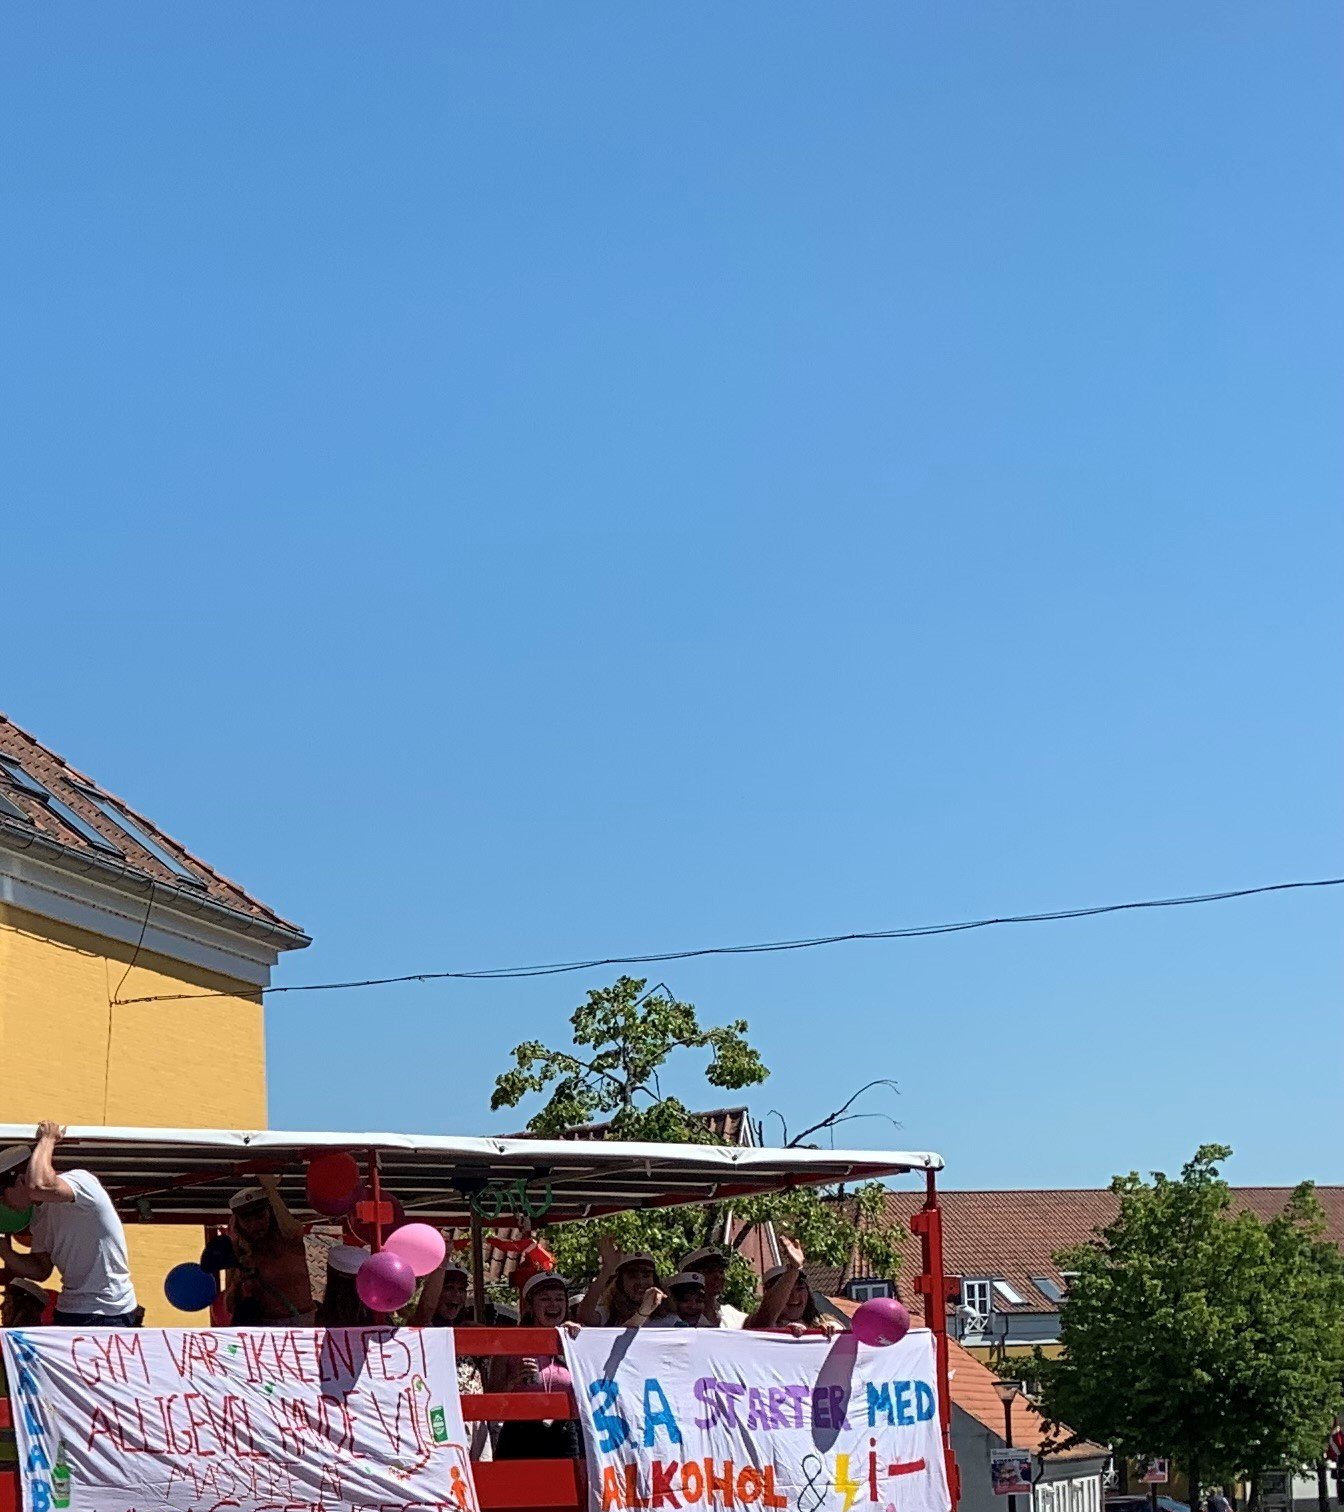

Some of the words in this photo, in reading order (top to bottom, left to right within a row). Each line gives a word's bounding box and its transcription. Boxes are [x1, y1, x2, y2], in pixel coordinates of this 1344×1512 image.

[72, 1333, 150, 1386] GYM
[162, 1330, 228, 1381] VAR
[237, 1330, 314, 1383] IKKE
[314, 1329, 356, 1382] EN
[362, 1327, 428, 1381] FEST
[88, 1393, 269, 1457] ALLIGEVEL
[694, 1376, 852, 1431] STARTER
[867, 1380, 936, 1427] MED
[601, 1457, 788, 1512] ALKOHOL
